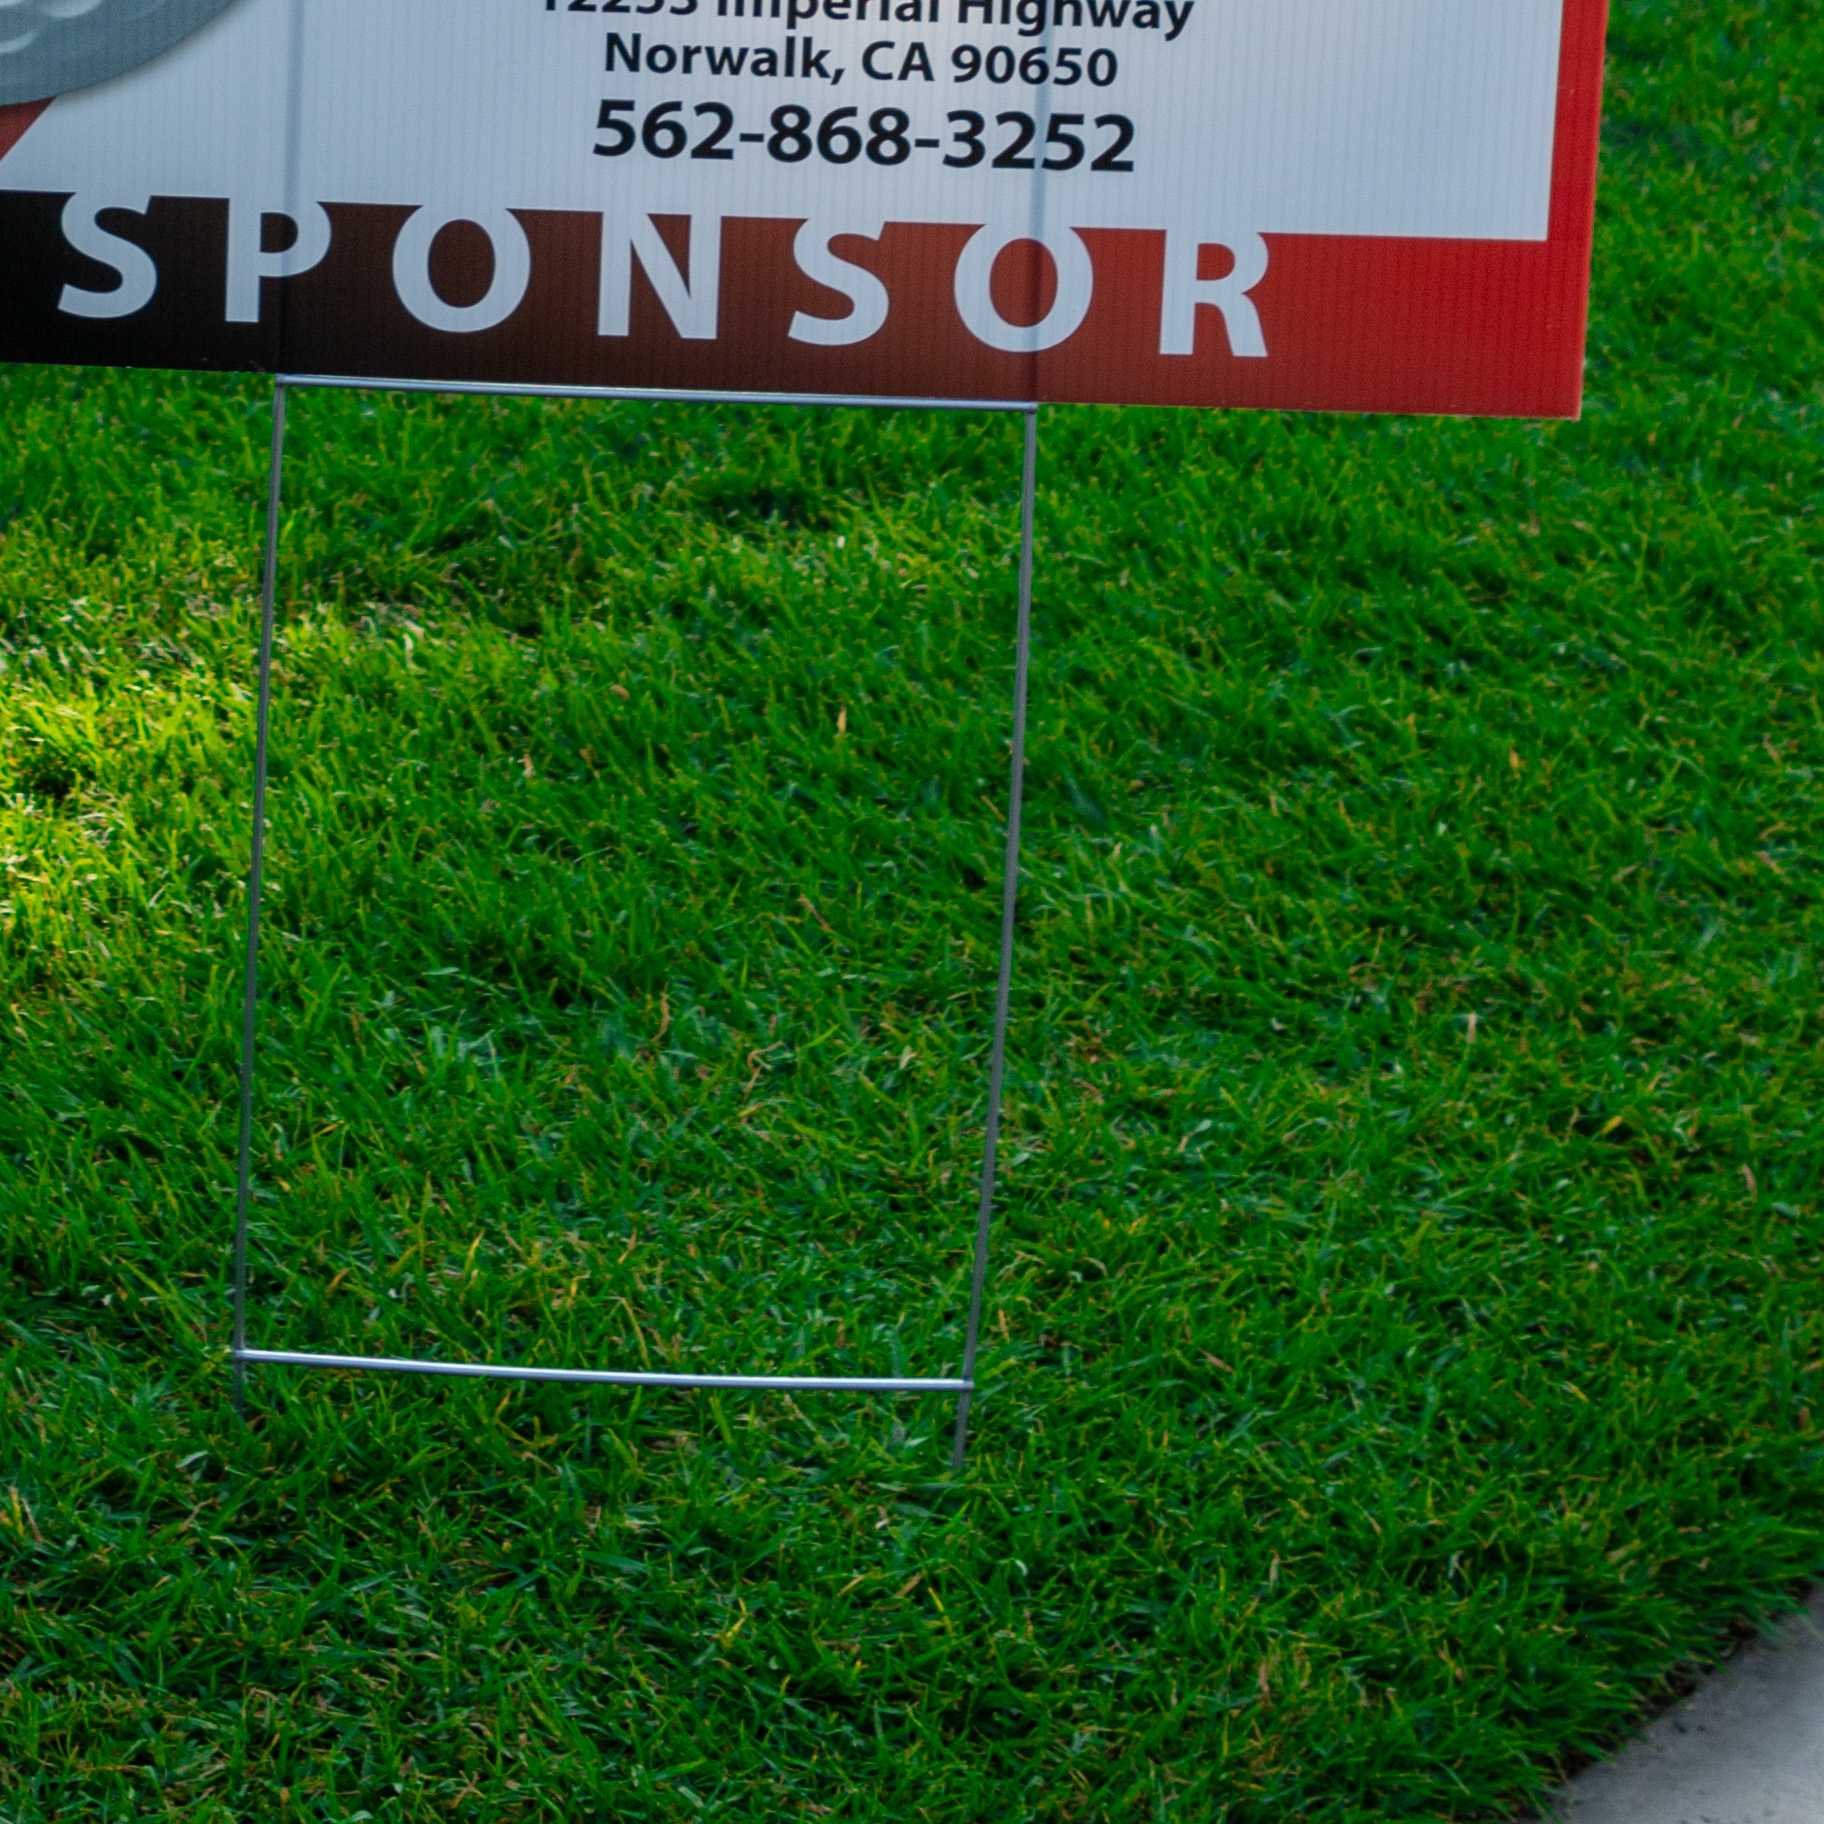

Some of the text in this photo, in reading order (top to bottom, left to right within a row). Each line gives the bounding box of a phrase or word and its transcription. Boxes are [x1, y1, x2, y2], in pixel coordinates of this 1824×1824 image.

[604, 33, 1118, 87] Norwalk, CA 90650
[592, 99, 1136, 172] 562-868-3252
[57, 189, 1270, 358] SPONSOR
